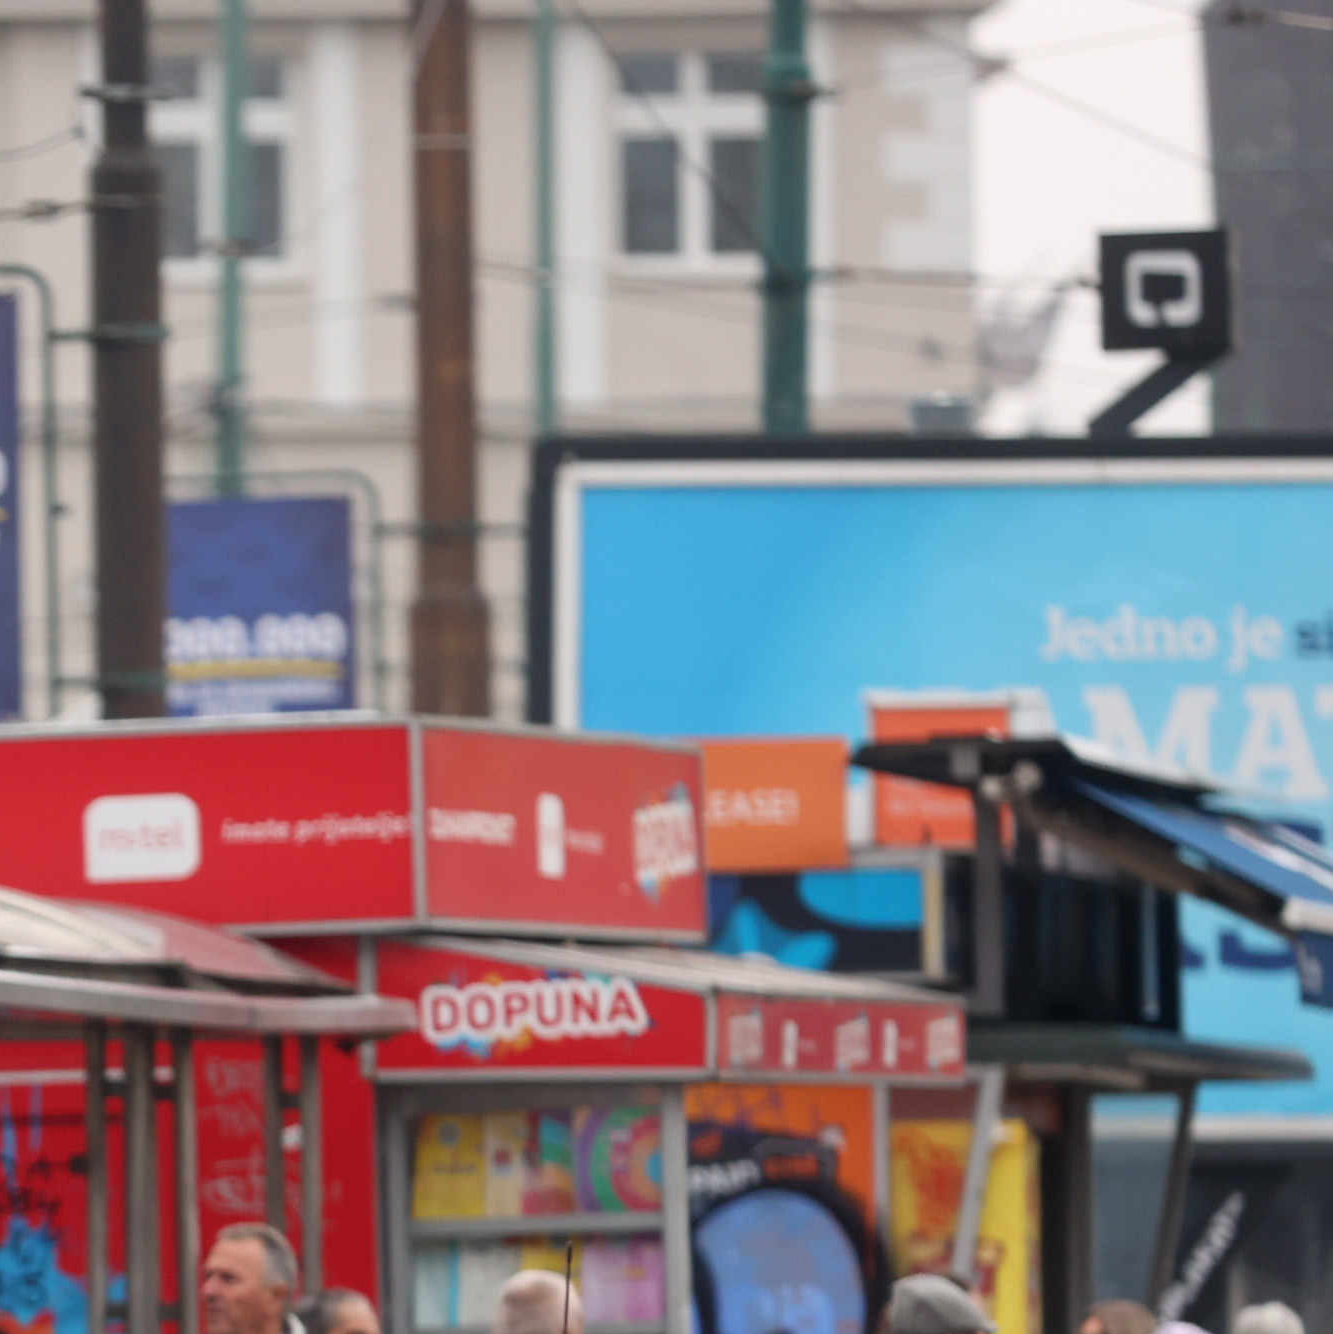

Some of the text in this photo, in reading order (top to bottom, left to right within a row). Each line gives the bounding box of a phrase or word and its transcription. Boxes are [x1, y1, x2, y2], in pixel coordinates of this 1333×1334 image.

[1039, 603, 1218, 663] Jedno
[1224, 603, 1283, 676] je
[424, 979, 648, 1040] DOPUNA
